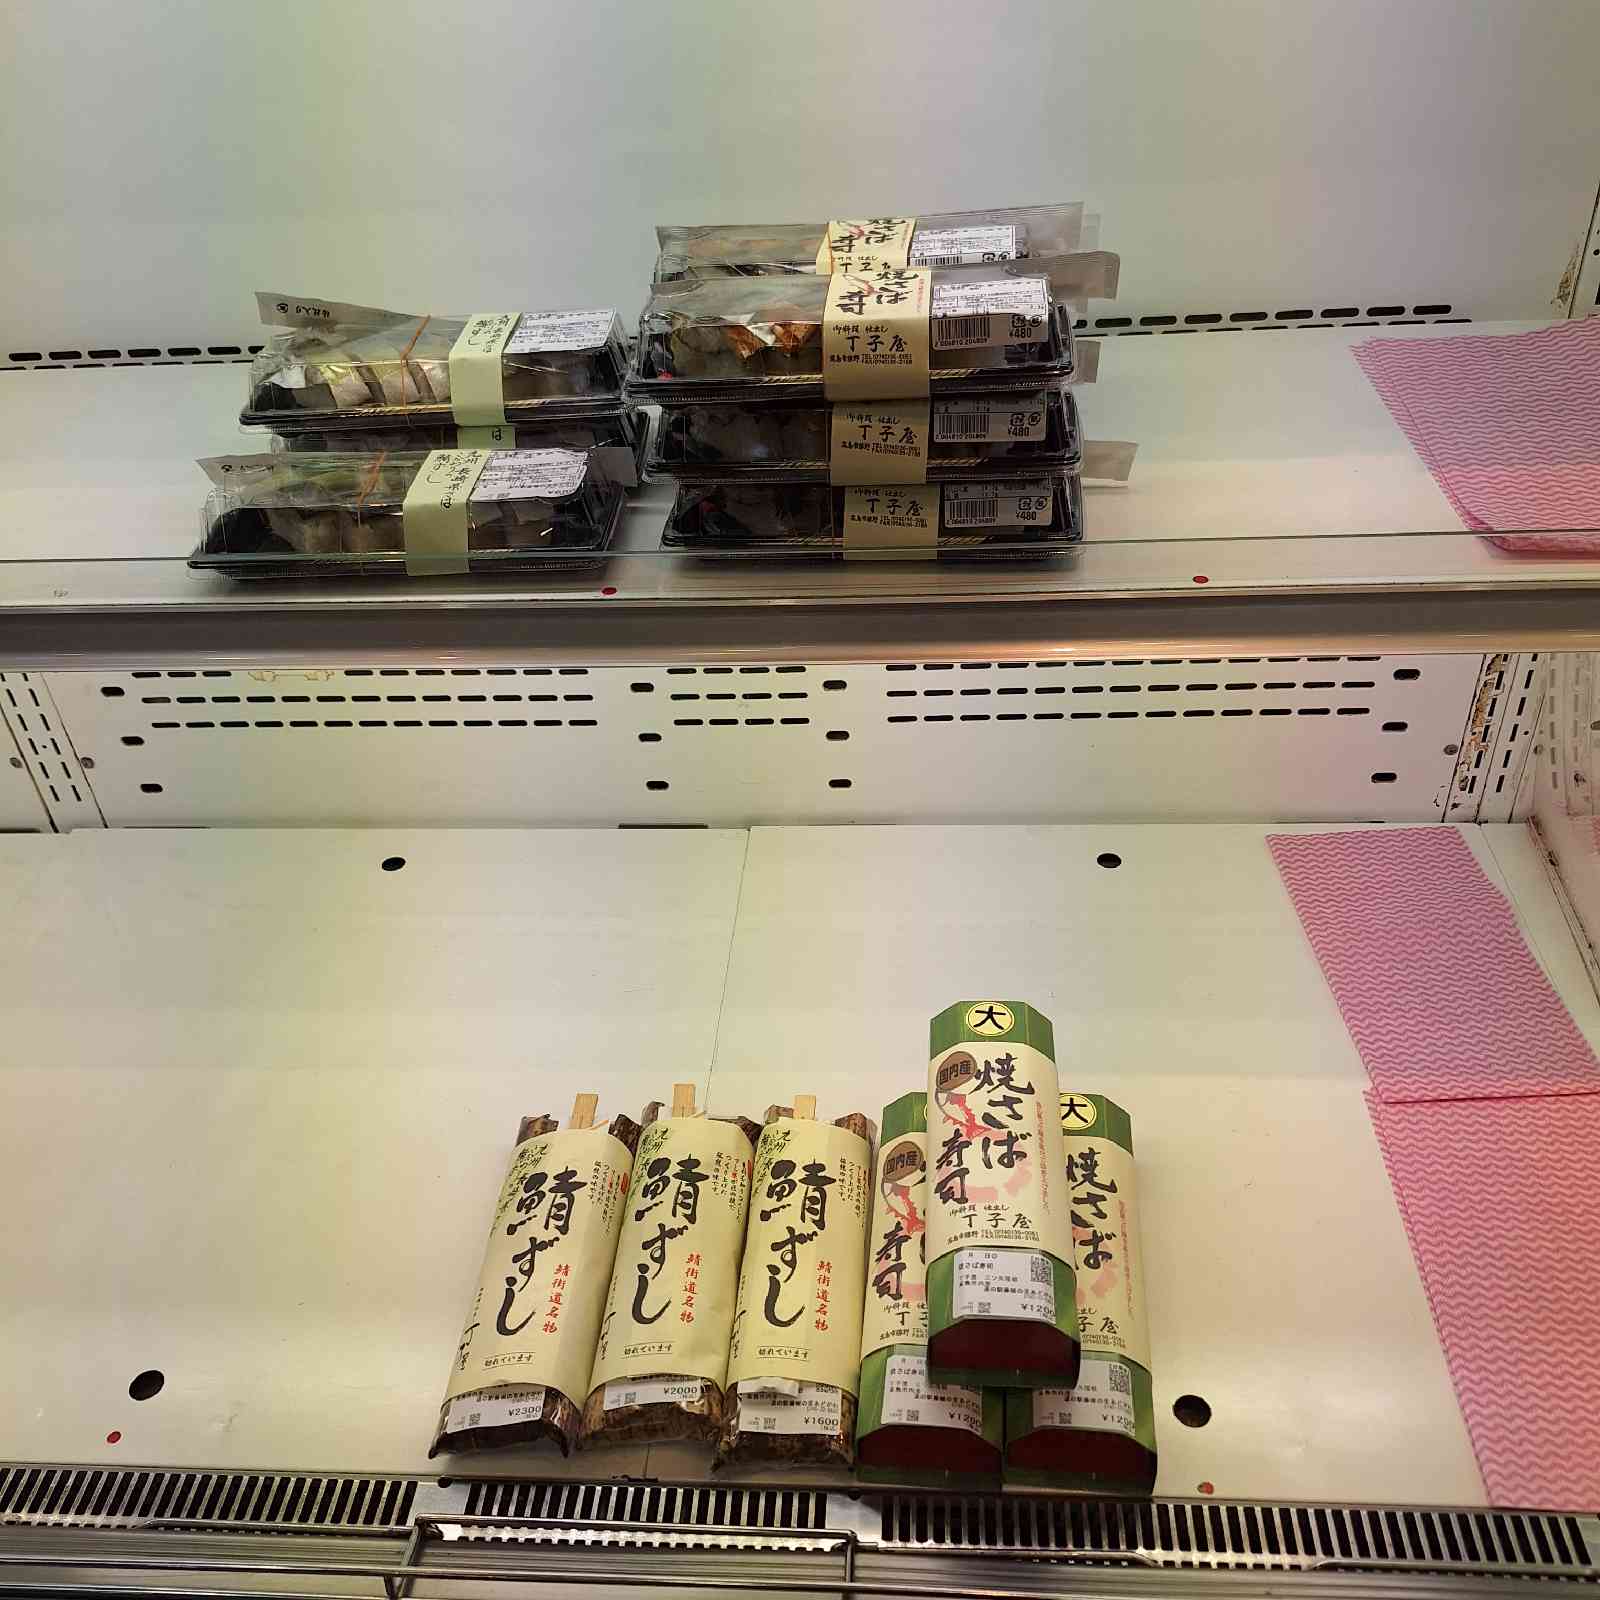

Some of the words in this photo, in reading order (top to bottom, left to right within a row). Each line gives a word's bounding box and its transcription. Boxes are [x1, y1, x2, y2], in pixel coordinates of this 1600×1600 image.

[845, 334, 909, 352] 丁子屋
[1008, 327, 1032, 338] ¥480
[858, 424, 918, 445] 丁子屋
[1008, 427, 1030, 437] ¥480
[865, 497, 924, 516] 丁子屋
[1016, 511, 1037, 520] ¥480
[973, 1005, 1007, 1030] 大
[938, 1059, 972, 1086] 国内産
[968, 1052, 1036, 1170] 焼さば
[1060, 1097, 1089, 1124] 大
[885, 1151, 918, 1175] 国内産
[934, 1128, 973, 1205] 寿司
[961, 1213, 1033, 1229] 丁子屋
[496, 1166, 588, 1336] 鯖ずし
[631, 1153, 710, 1325] 鯖ずし
[760, 1157, 838, 1328] 鯖ずし
[872, 1220, 913, 1301] 寿司
[542, 1264, 572, 1334] 鯖街道名物
[679, 1253, 703, 1323] 鯖街道名物
[814, 1260, 834, 1332] 鯖街道名物
[663, 1386, 698, 1395] ¥2000
[508, 1405, 542, 1417] ¥2300
[803, 1416, 839, 1426] ¥1600
